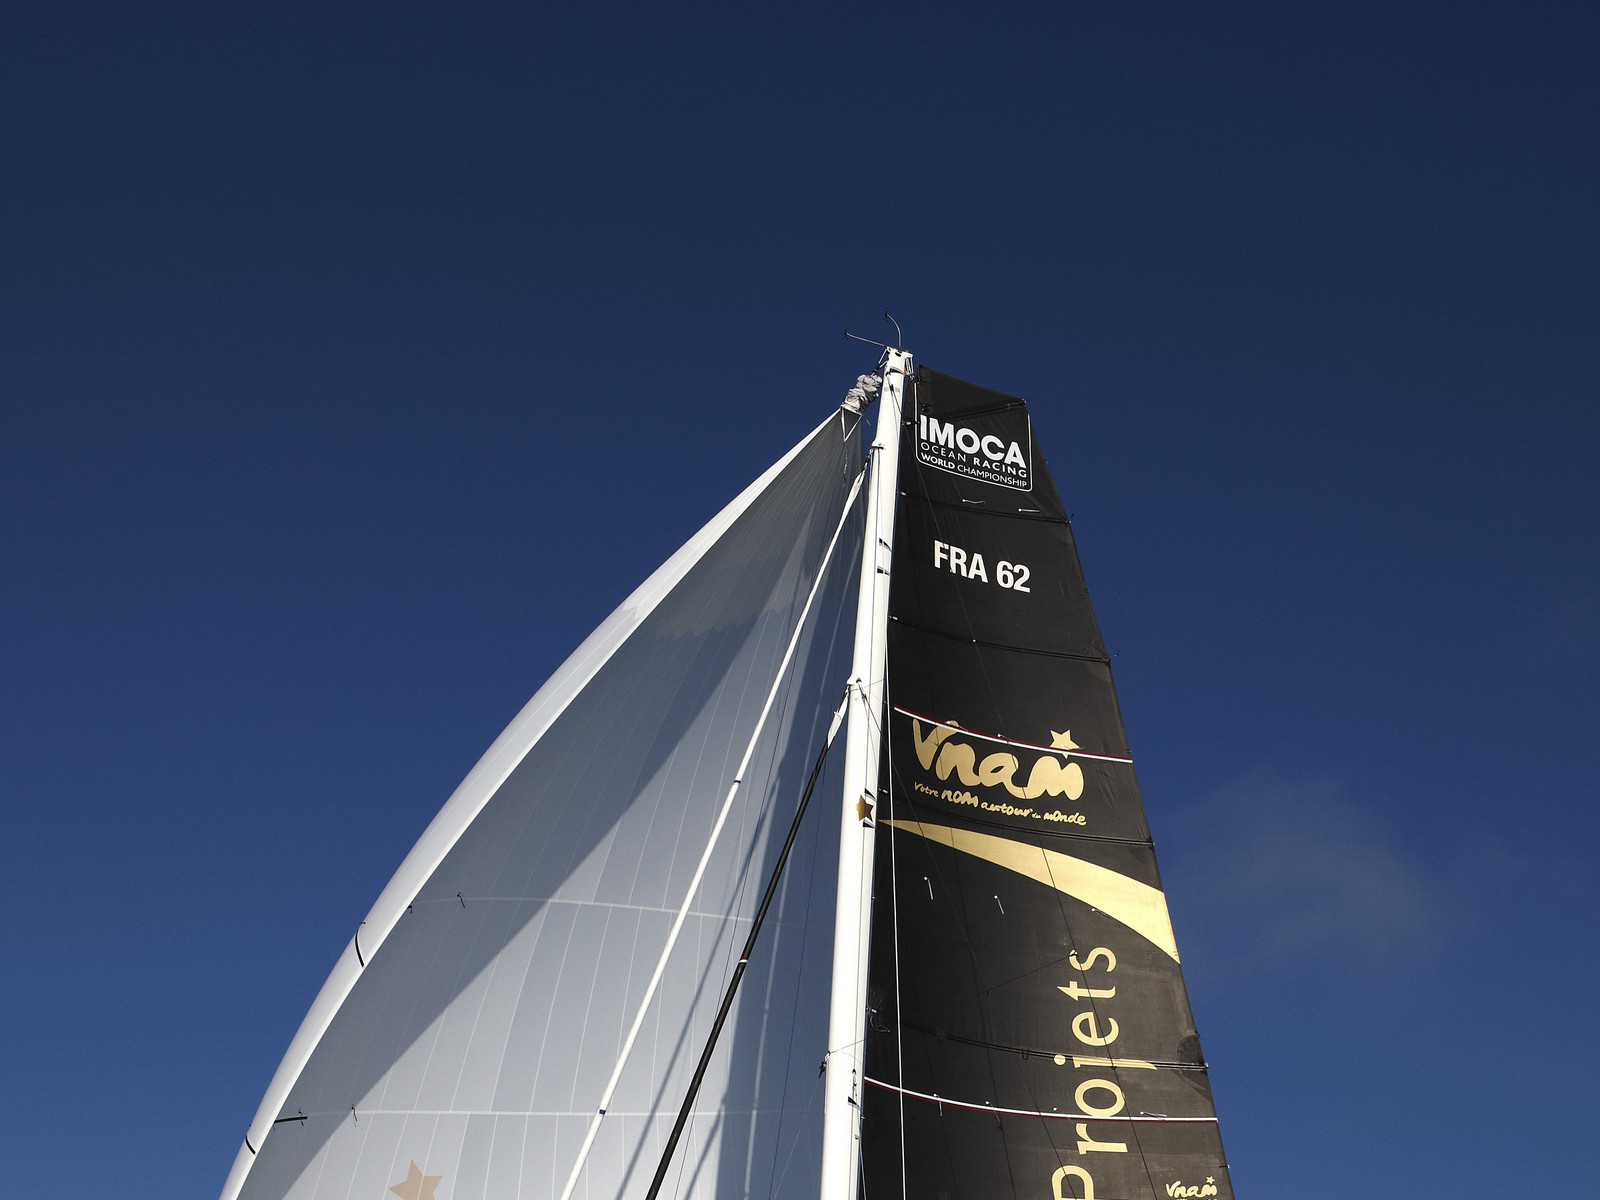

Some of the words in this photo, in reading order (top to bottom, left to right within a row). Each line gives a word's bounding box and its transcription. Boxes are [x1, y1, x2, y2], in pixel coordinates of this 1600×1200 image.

[920, 414, 1027, 469] IMOCA
[920, 441, 967, 463] OCEAN
[973, 456, 1028, 479] RACING
[920, 452, 956, 470] WORLD
[957, 464, 1028, 488] CHAMPIONSHIP
[934, 539, 989, 584] FRA
[996, 560, 1031, 594] 62
